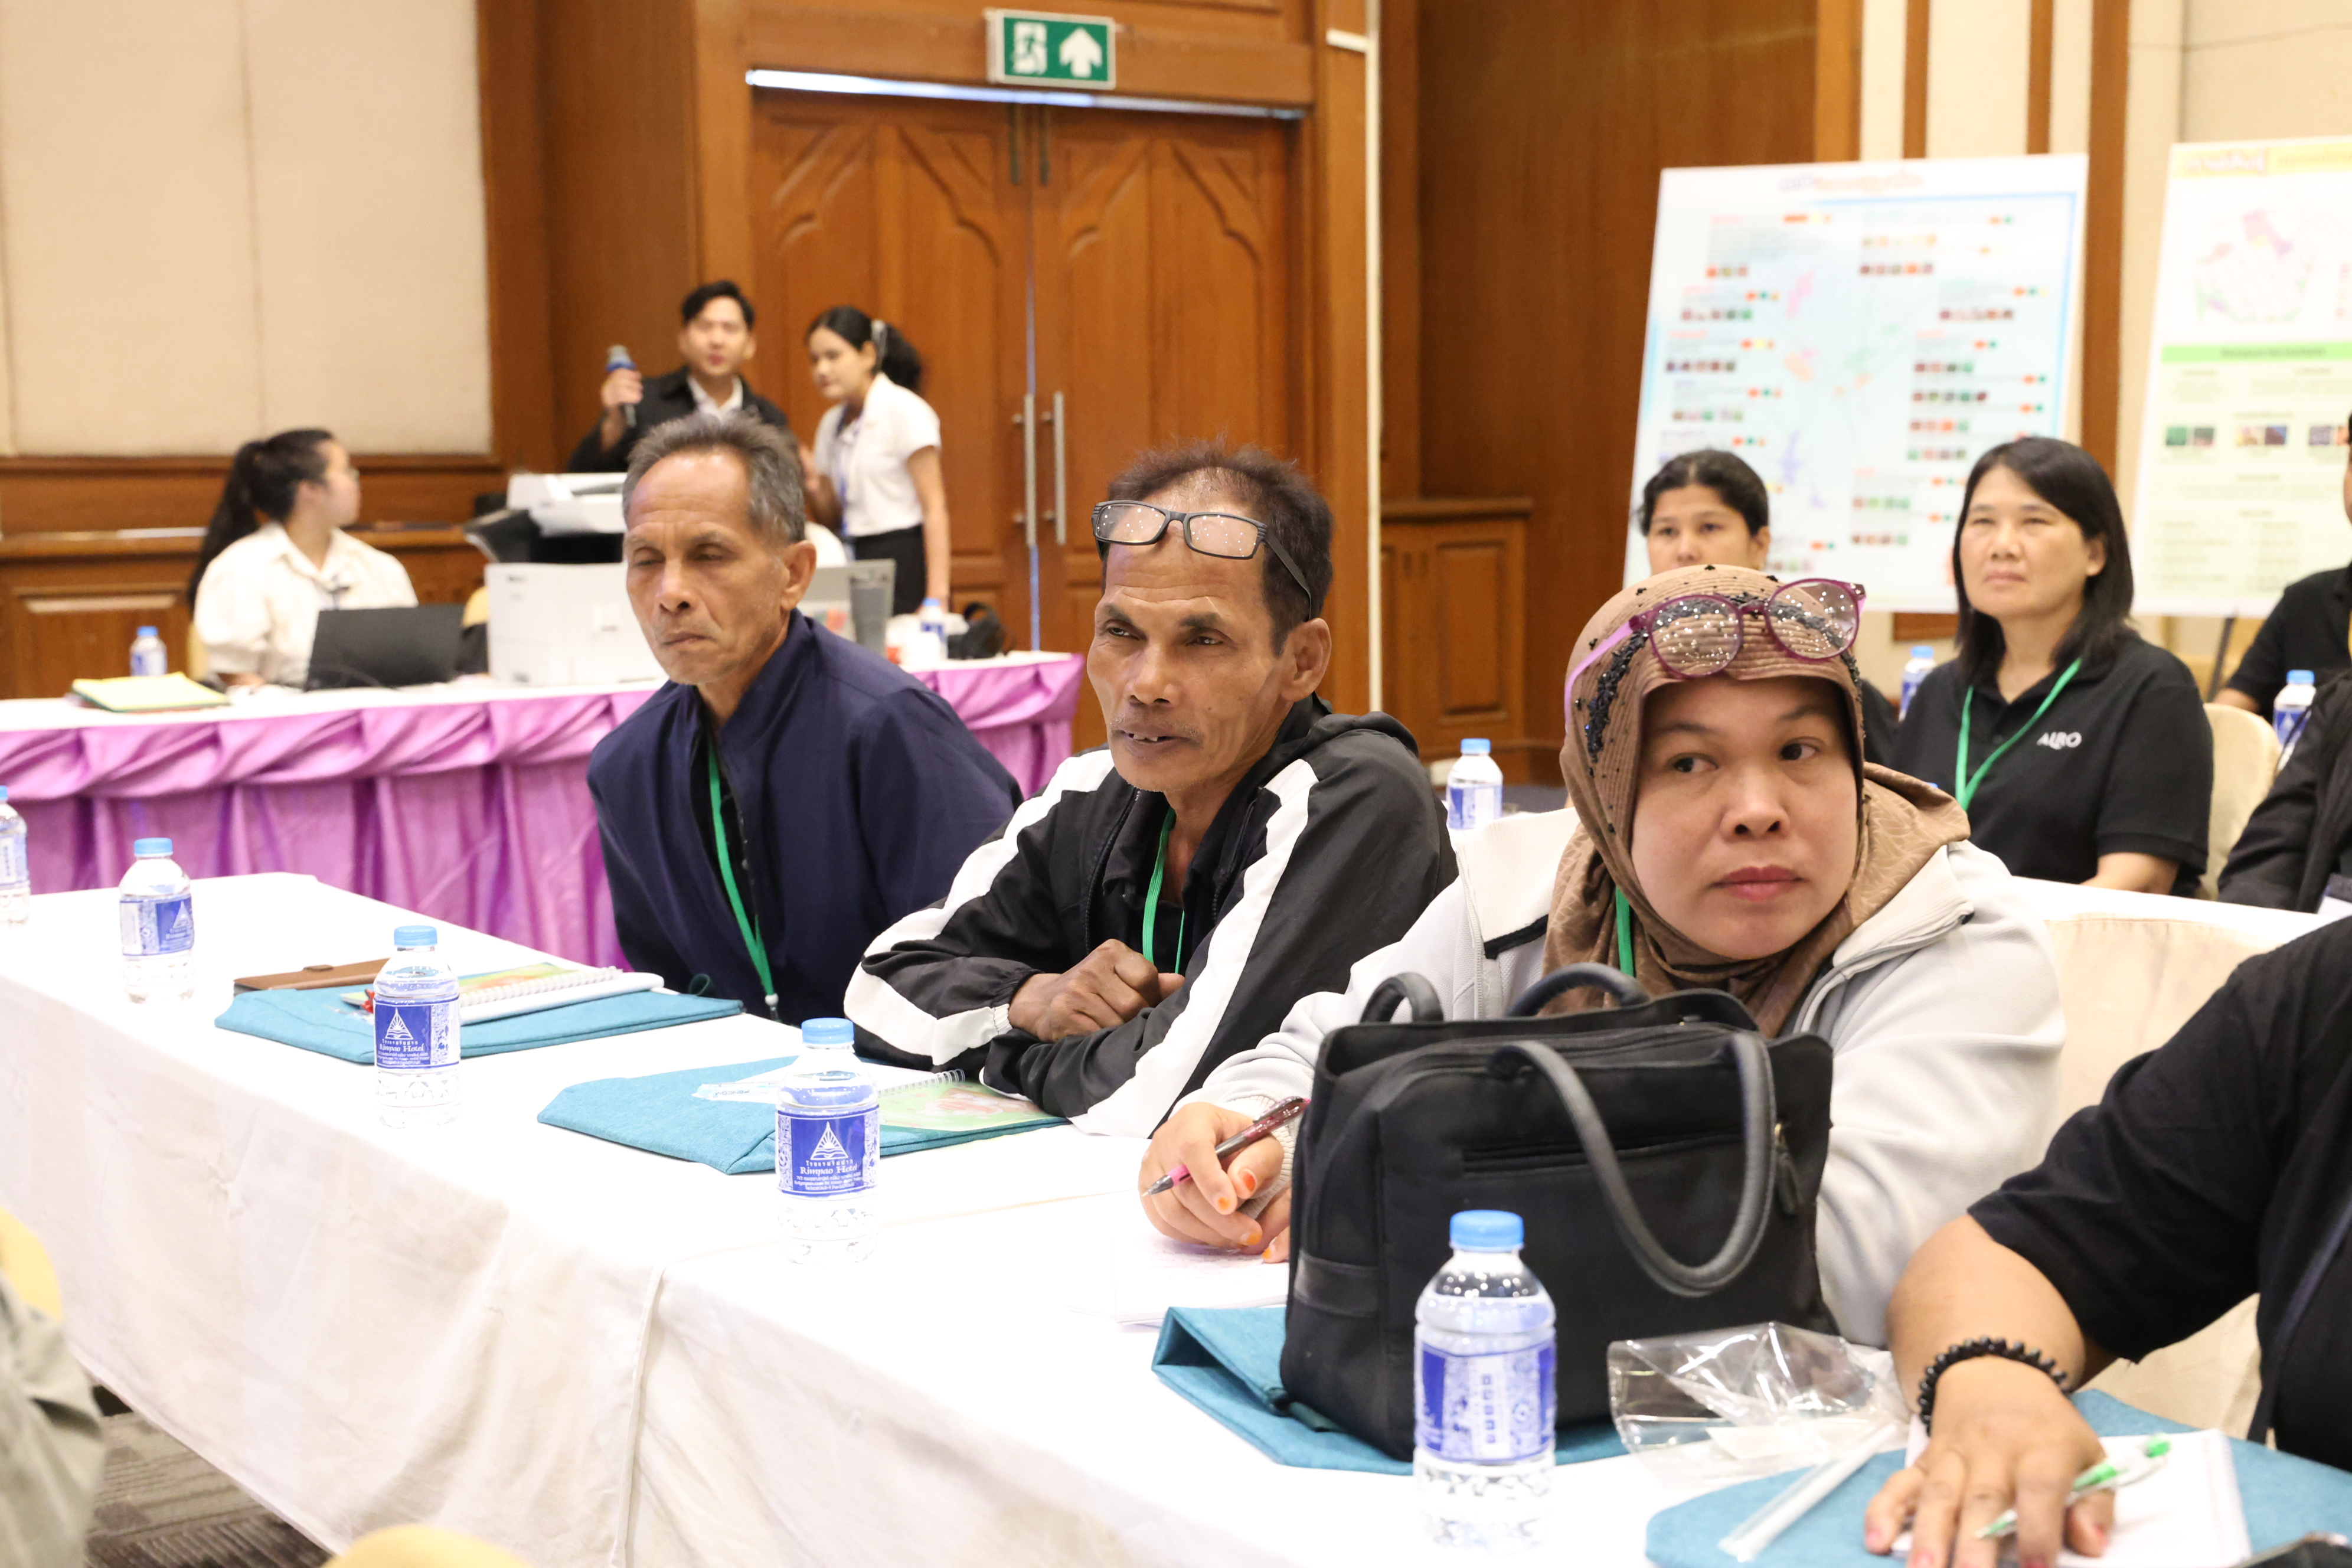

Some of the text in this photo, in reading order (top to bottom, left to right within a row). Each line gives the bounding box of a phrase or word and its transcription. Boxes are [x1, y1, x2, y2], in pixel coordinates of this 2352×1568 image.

[380, 1043, 424, 1053] Rimpao Hotel
[800, 1163, 858, 1177] Rimpao Hotel
